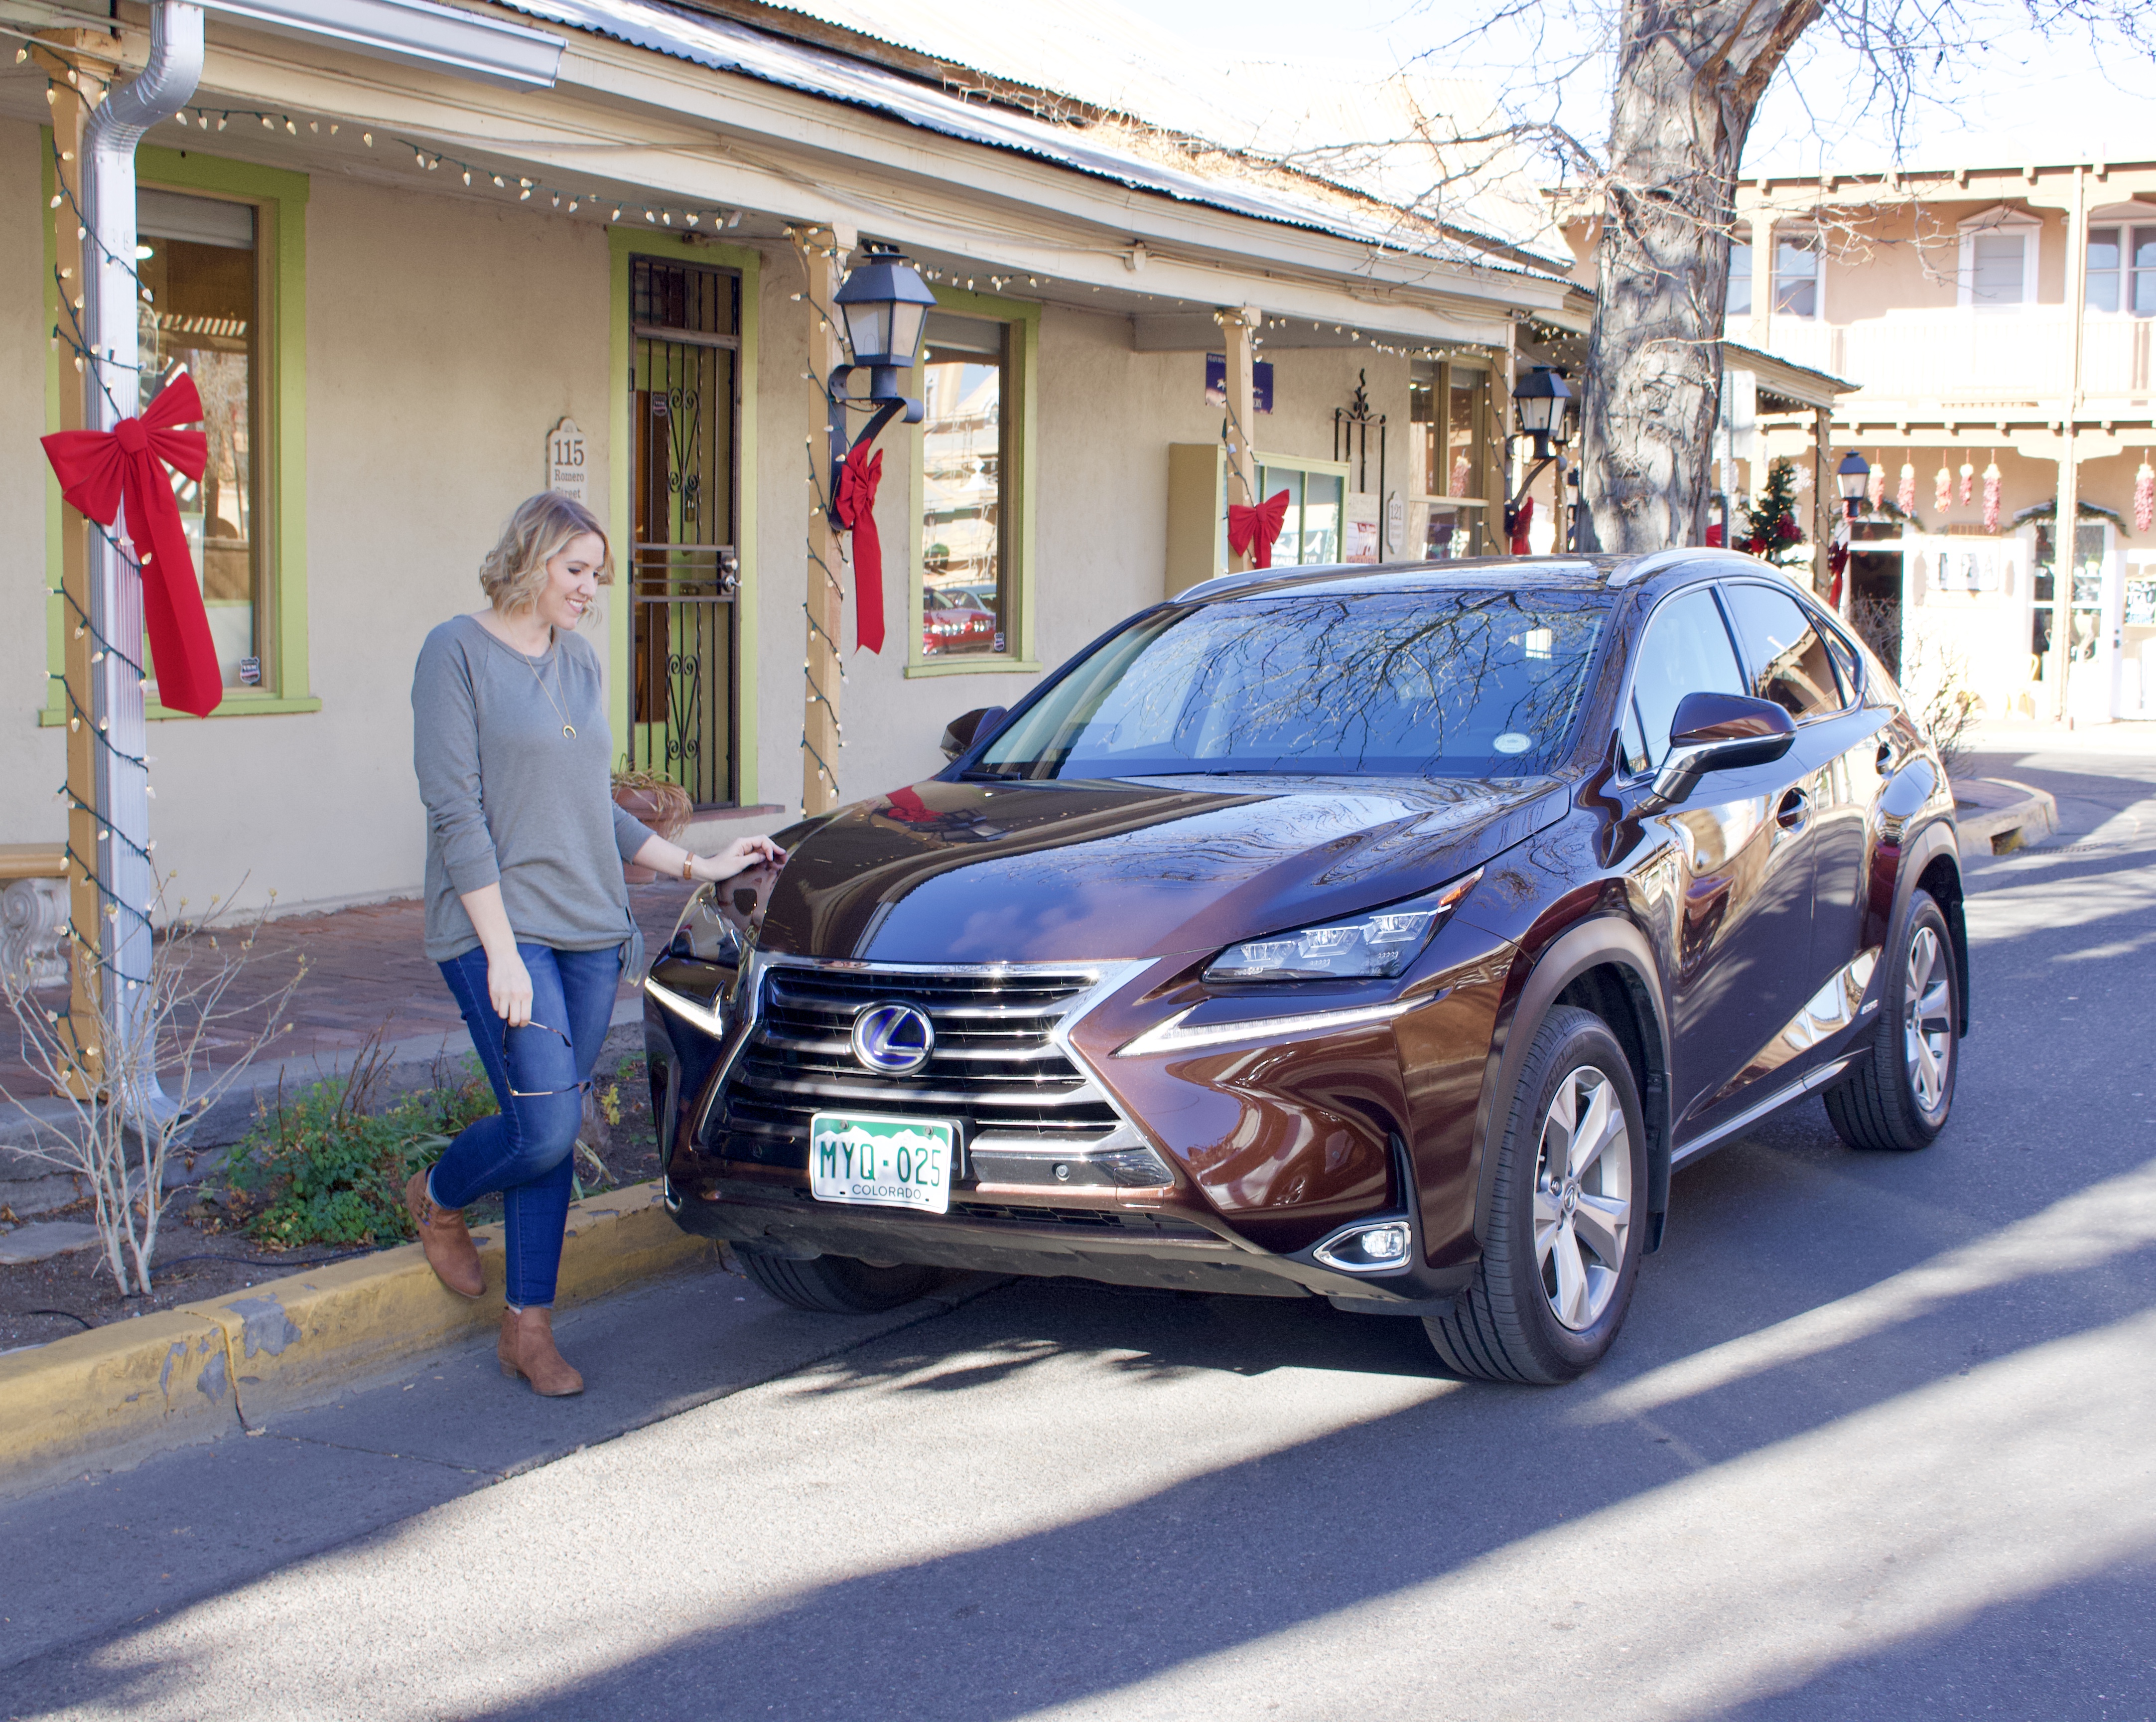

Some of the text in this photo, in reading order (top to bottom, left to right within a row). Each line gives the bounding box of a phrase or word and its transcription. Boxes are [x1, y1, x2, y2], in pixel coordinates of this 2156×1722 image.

[554, 439, 584, 466] 115
[554, 469, 584, 482] Romero
[1391, 504, 1402, 520] 121
[852, 1184, 921, 1199] COLORADO
